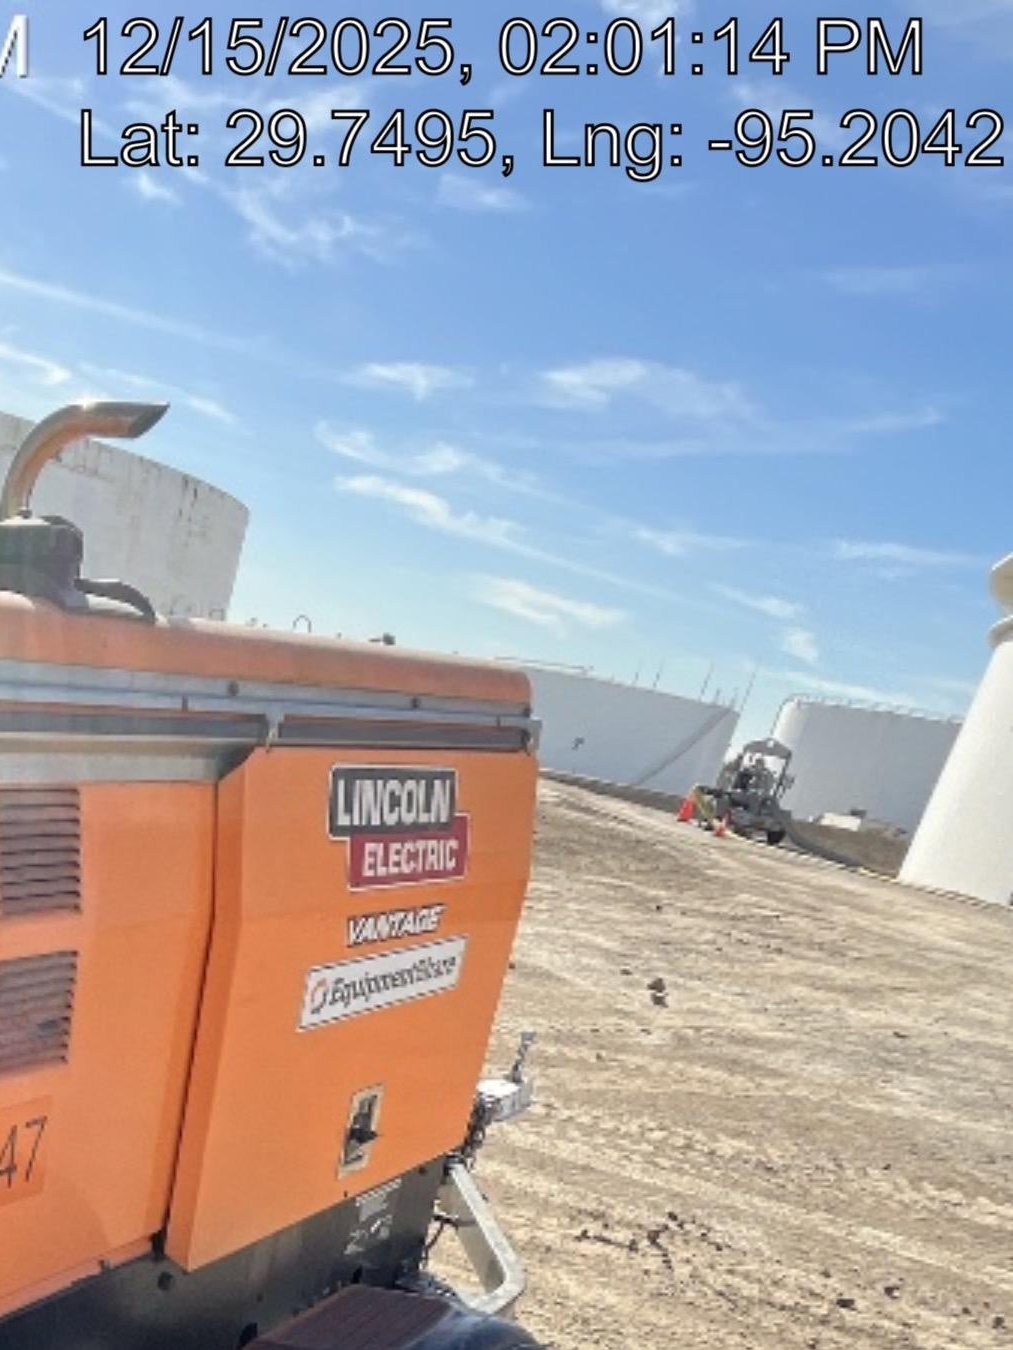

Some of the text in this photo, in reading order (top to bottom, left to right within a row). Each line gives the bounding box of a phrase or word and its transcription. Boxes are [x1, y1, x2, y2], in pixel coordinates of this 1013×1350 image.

[337, 778, 452, 827] LINCOLN
[362, 838, 459, 878] ELECTRIC
[347, 902, 447, 948] VANTAGE
